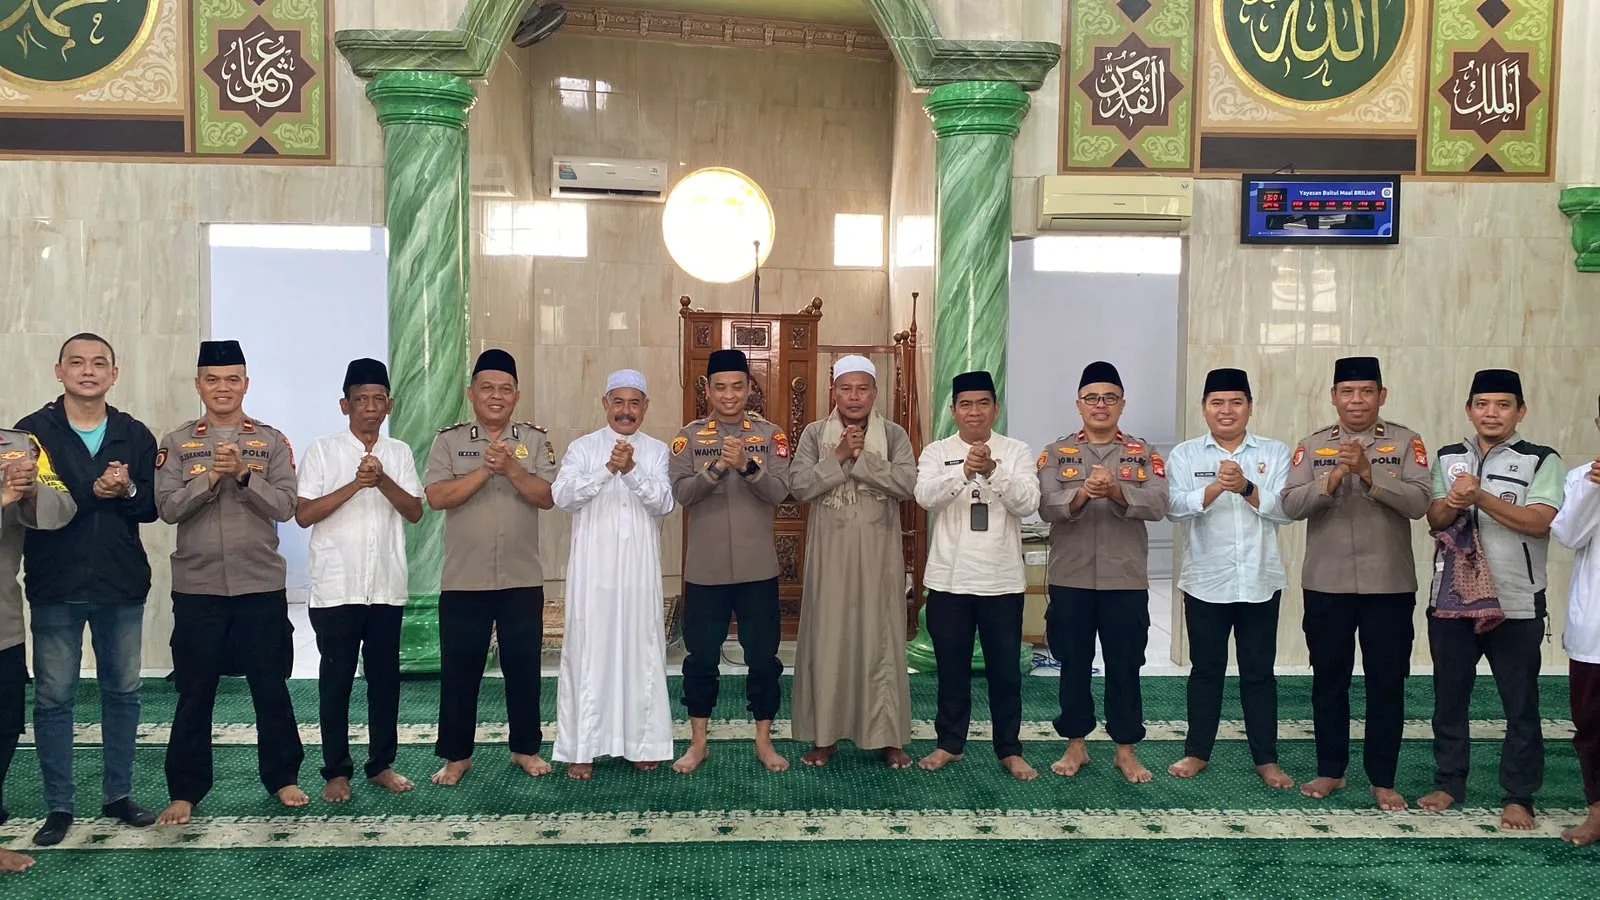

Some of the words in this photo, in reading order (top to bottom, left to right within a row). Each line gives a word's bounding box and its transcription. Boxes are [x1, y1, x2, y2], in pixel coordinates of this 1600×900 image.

[242, 449, 270, 459] POLRI
[1371, 457, 1401, 465] POLRI
[1509, 465, 1519, 473] 12
